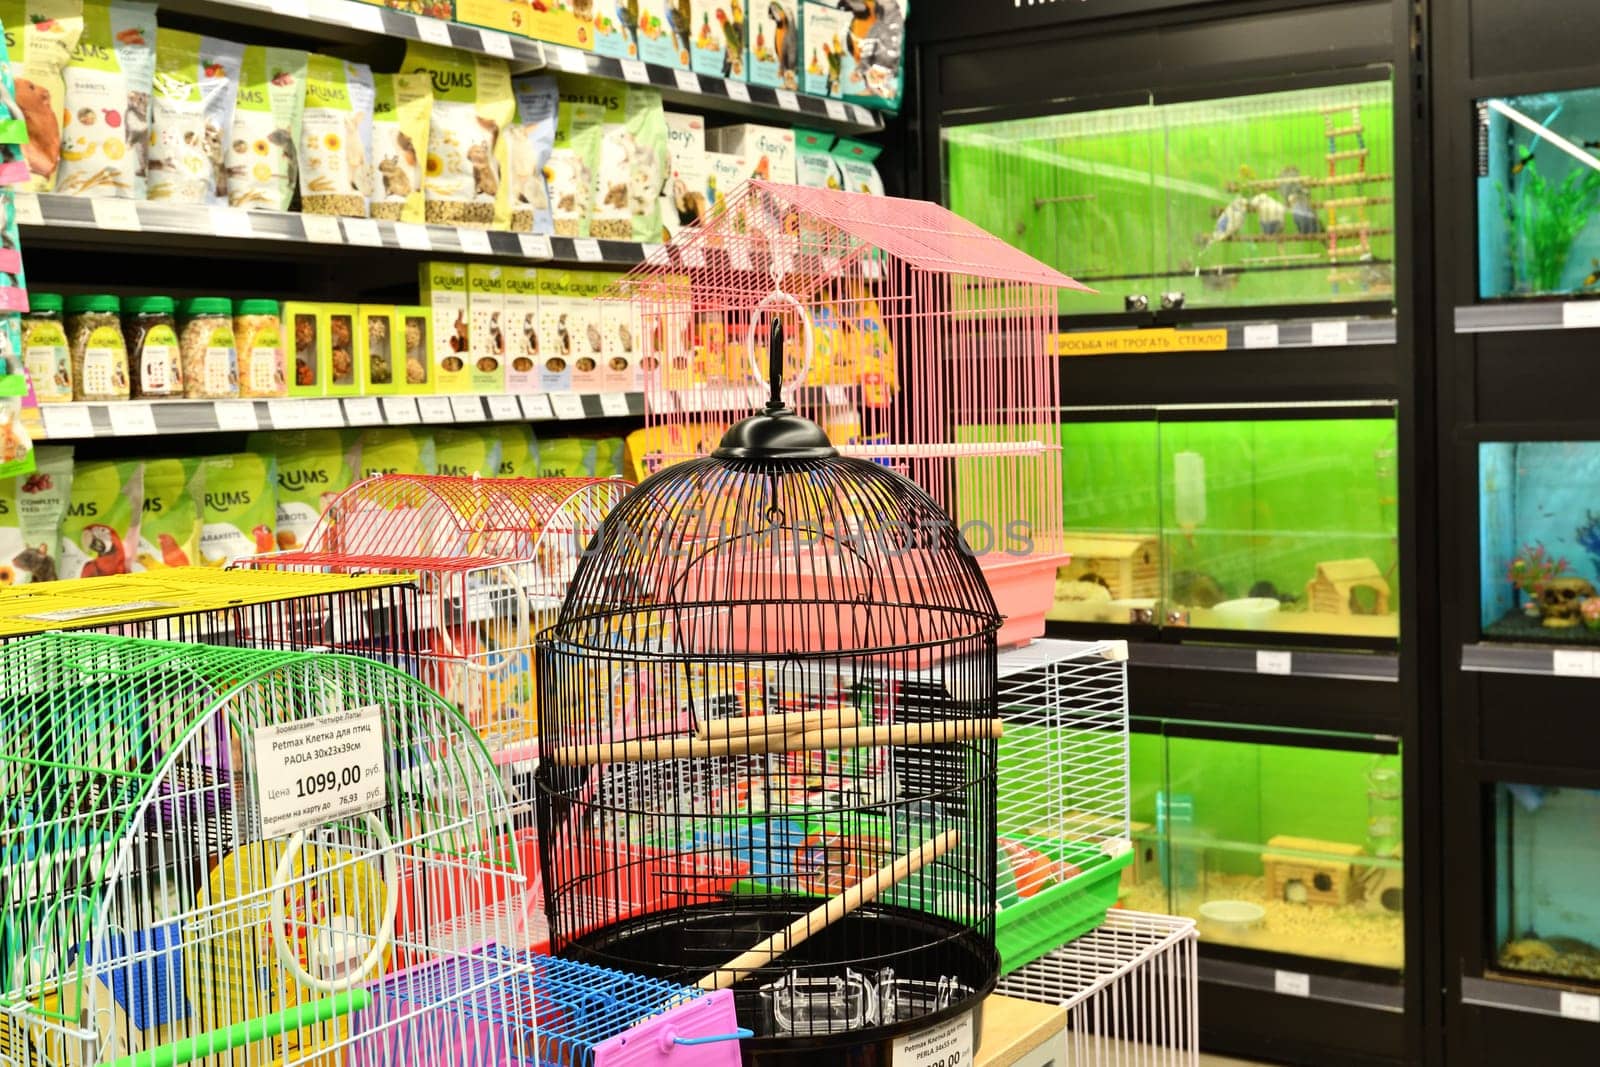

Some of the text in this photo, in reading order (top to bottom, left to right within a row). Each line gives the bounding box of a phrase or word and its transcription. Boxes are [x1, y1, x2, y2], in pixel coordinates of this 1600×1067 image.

[433, 276, 464, 290] GRUMS
[472, 277, 502, 292] GRUMS
[507, 279, 535, 294] GRUMS
[570, 284, 598, 297] GRUMS
[1106, 340, 1120, 349] НЕ
[1177, 333, 1223, 346] СТЕКЛО
[272, 723, 371, 751] Petmax Клетка для птиц
[284, 751, 312, 766] PAOLA
[268, 787, 290, 800] Цена
[296, 764, 361, 798] 1099,00
[263, 812, 292, 825] Вернем
[302, 803, 322, 816] карту
[322, 801, 331, 810] до
